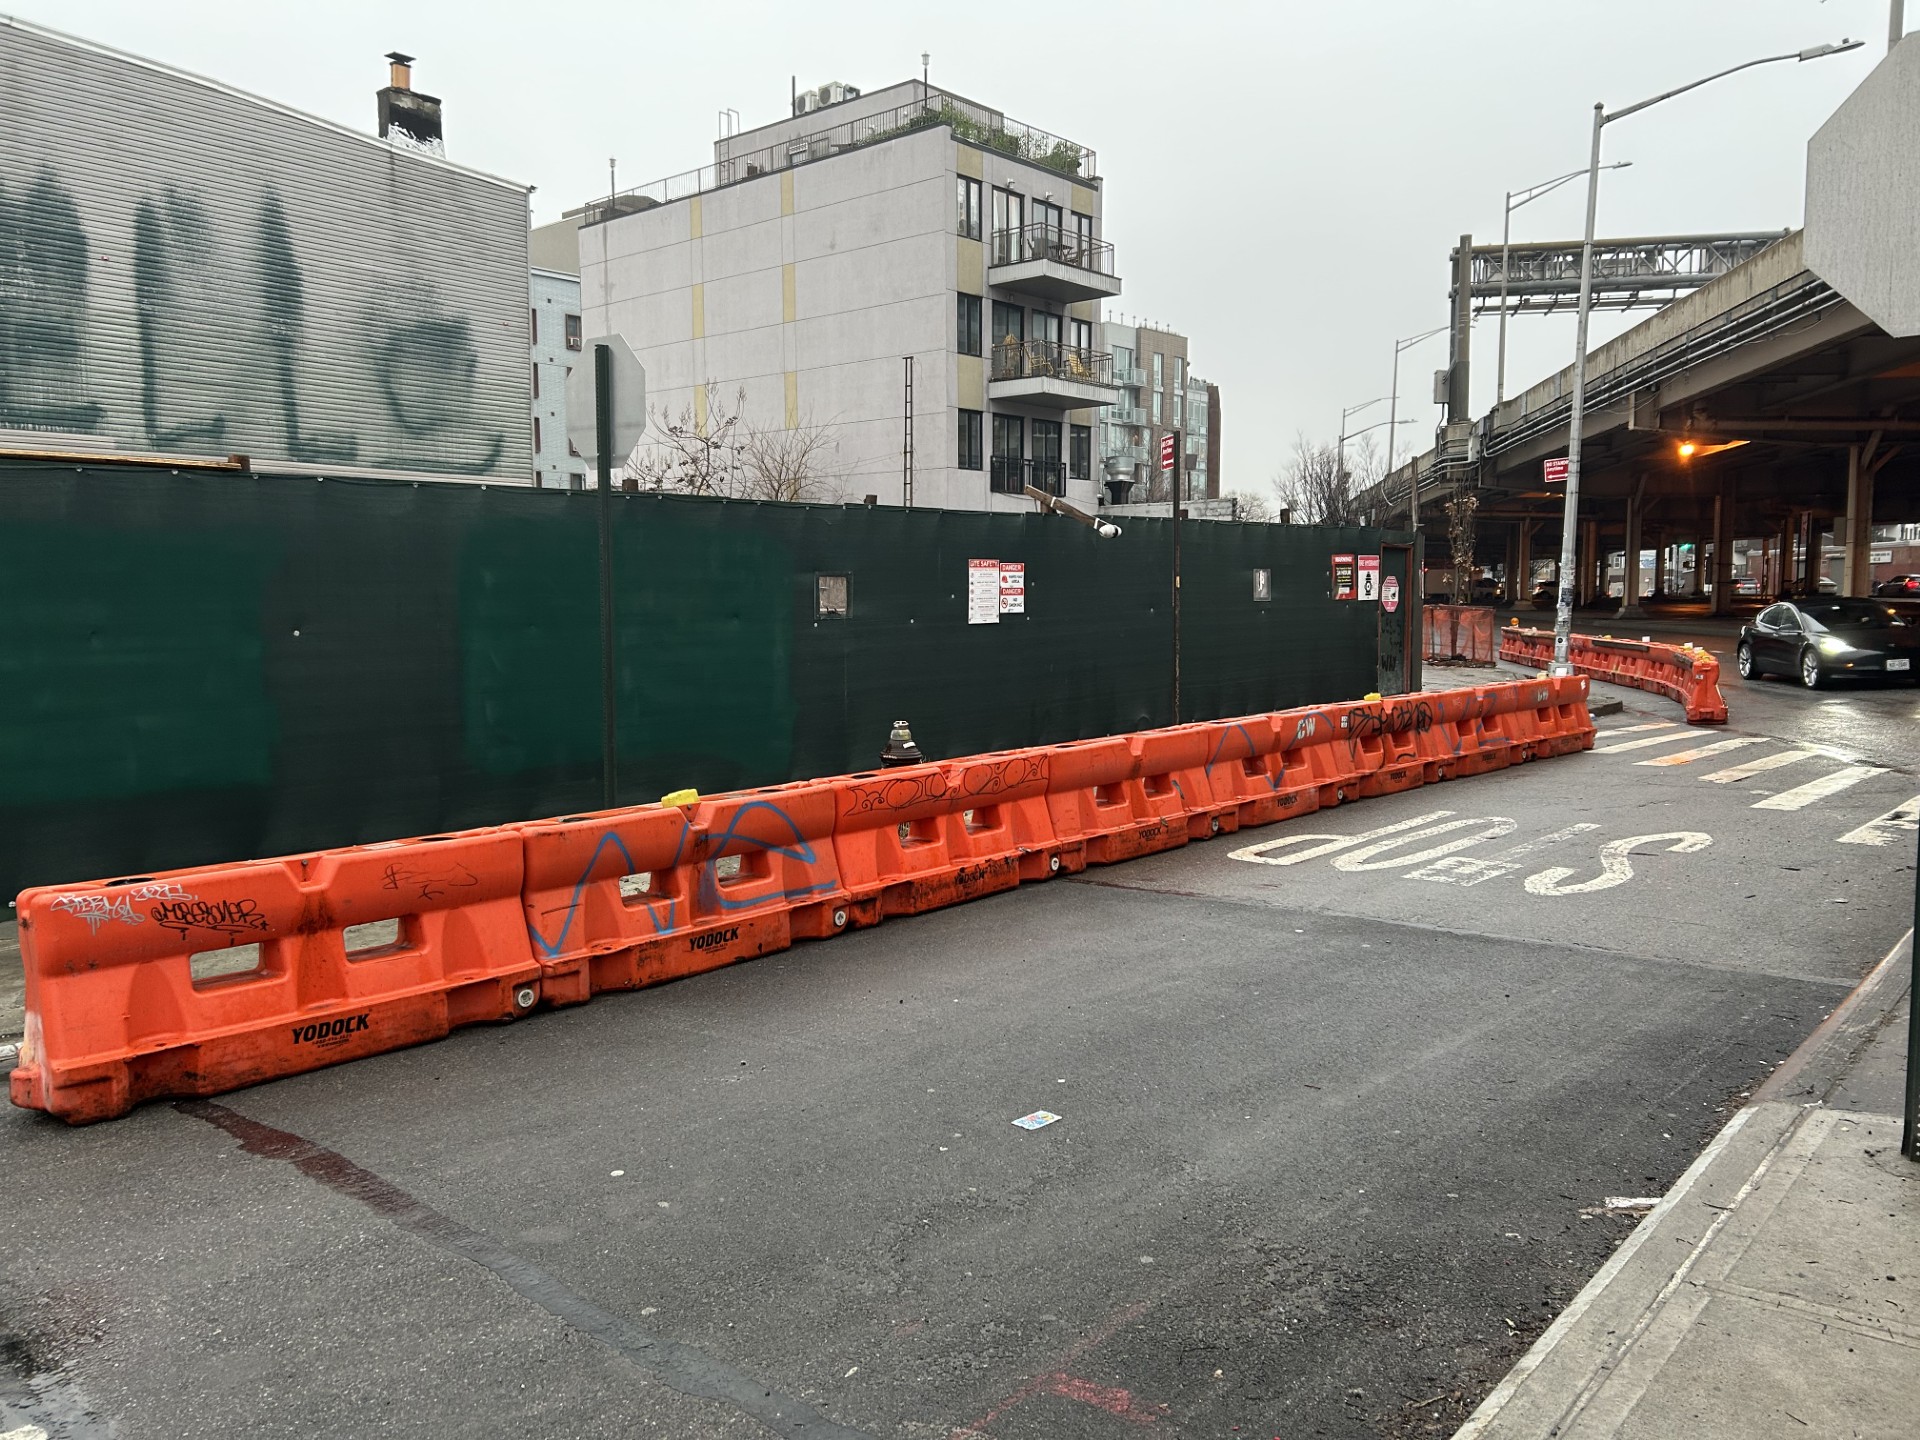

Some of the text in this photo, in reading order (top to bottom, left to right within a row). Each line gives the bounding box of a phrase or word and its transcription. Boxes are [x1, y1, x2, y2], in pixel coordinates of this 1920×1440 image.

[1227, 811, 1714, 896] STOP
[690, 926, 739, 951] YODOCK
[292, 1013, 370, 1044] YODOCK
